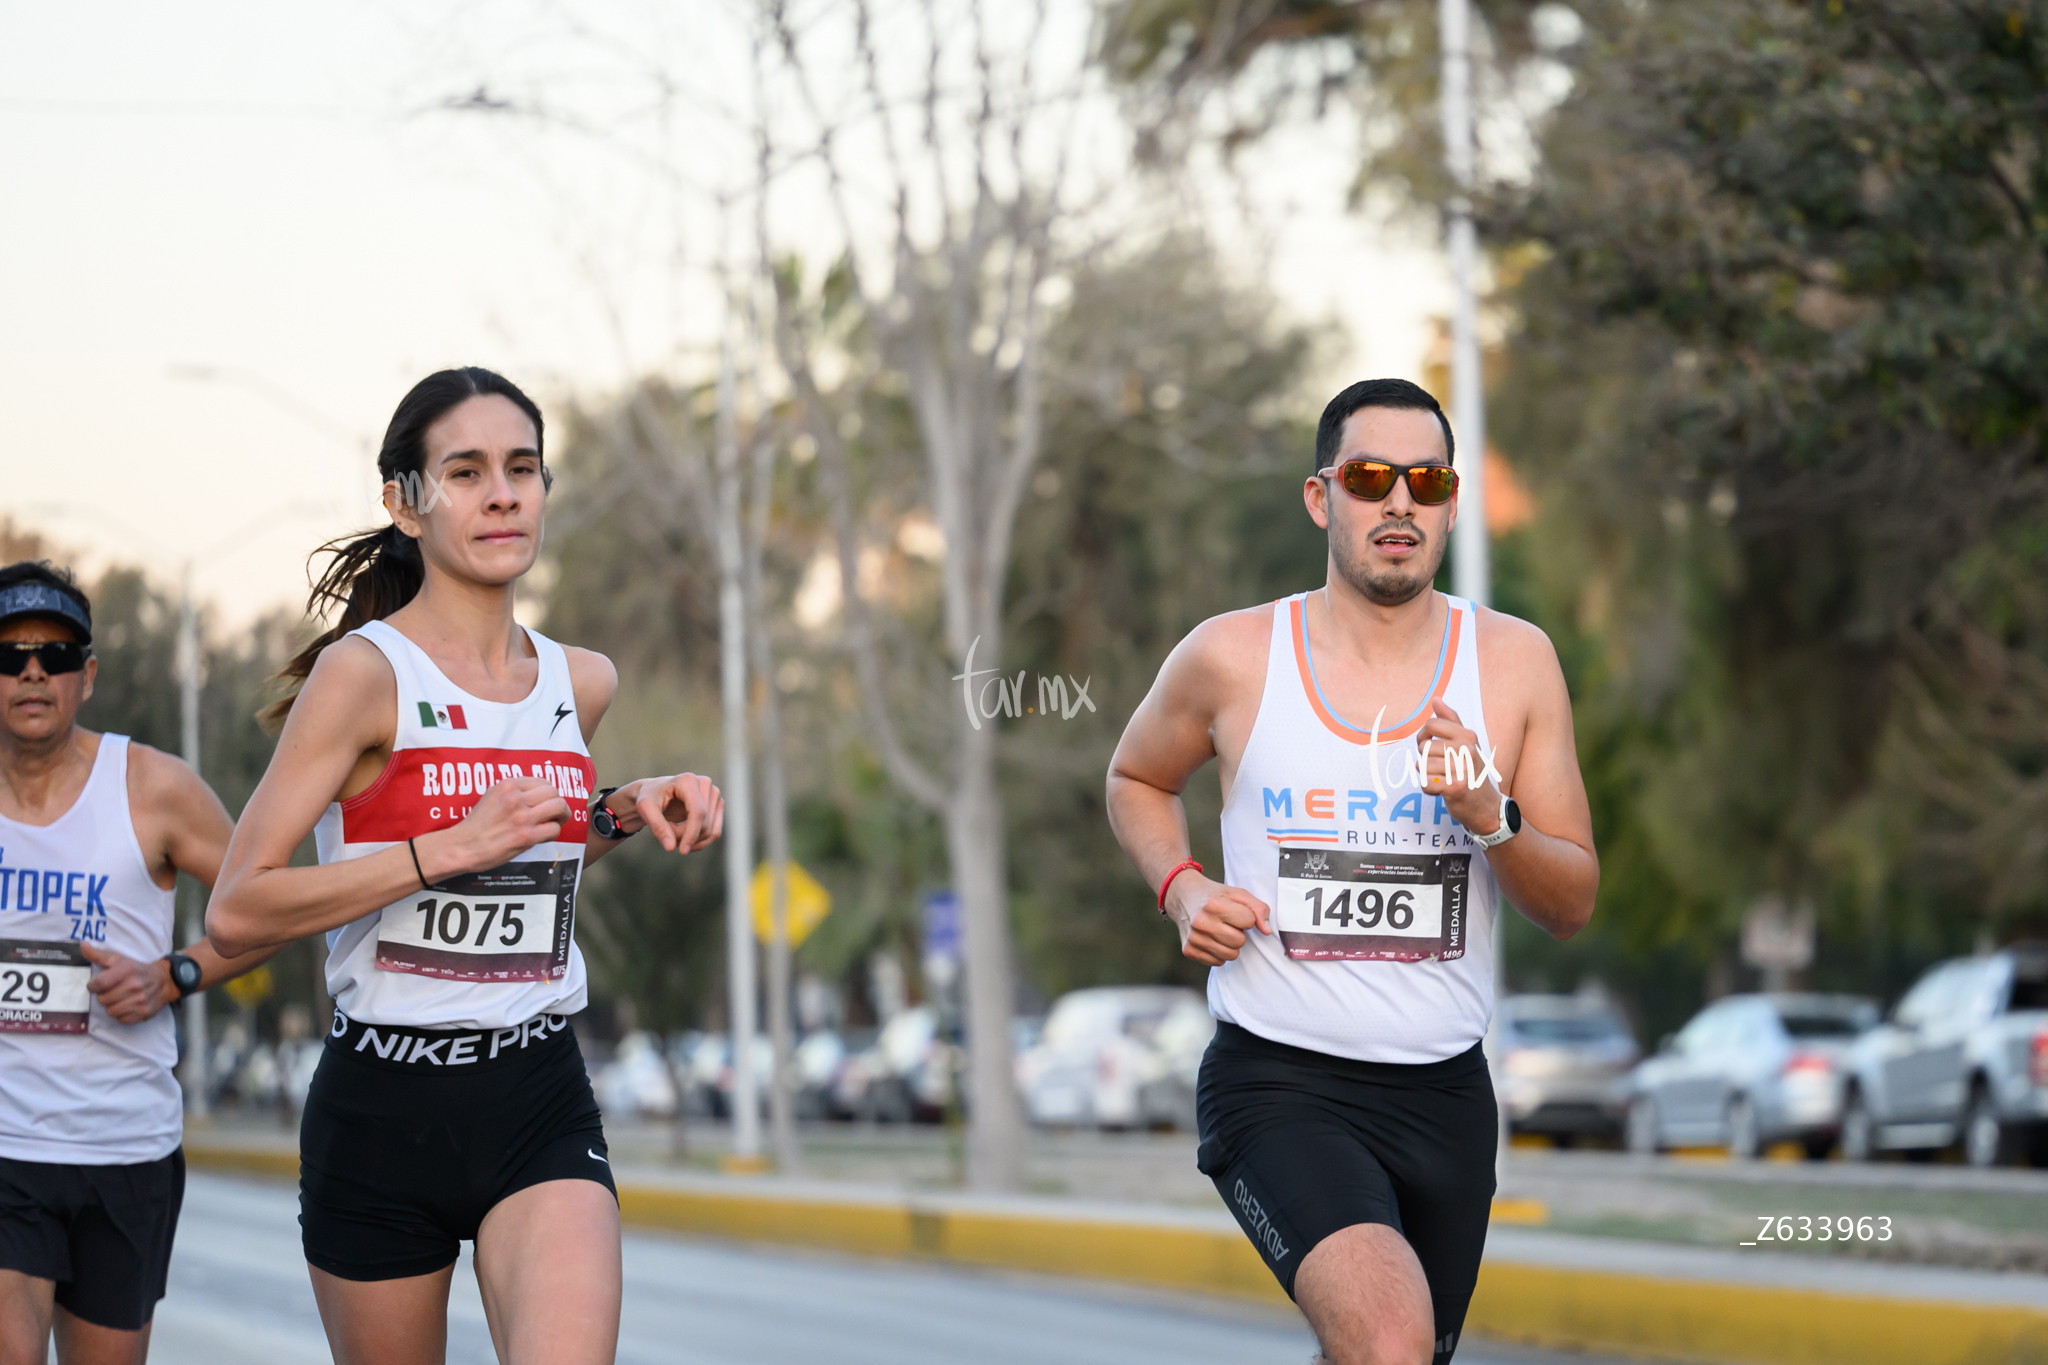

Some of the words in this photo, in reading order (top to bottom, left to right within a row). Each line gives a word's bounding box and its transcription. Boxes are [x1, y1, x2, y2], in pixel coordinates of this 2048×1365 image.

[430, 806, 473, 820] CLU
[1347, 830, 1474, 848] RUN-TEAM
[416, 898, 525, 946] 1075
[558, 893, 571, 961] MEDALLA
[1305, 887, 1415, 930] 1496
[1450, 884, 1461, 946] MEDALLA
[70, 918, 107, 942] ZAC
[552, 965, 566, 976] 1075
[1443, 950, 1463, 959] 1496
[1, 970, 50, 1004] 29
[354, 1027, 482, 1065] NIKE
[488, 1014, 567, 1059] PRO
[1234, 1178, 1290, 1261] ADIZERO
